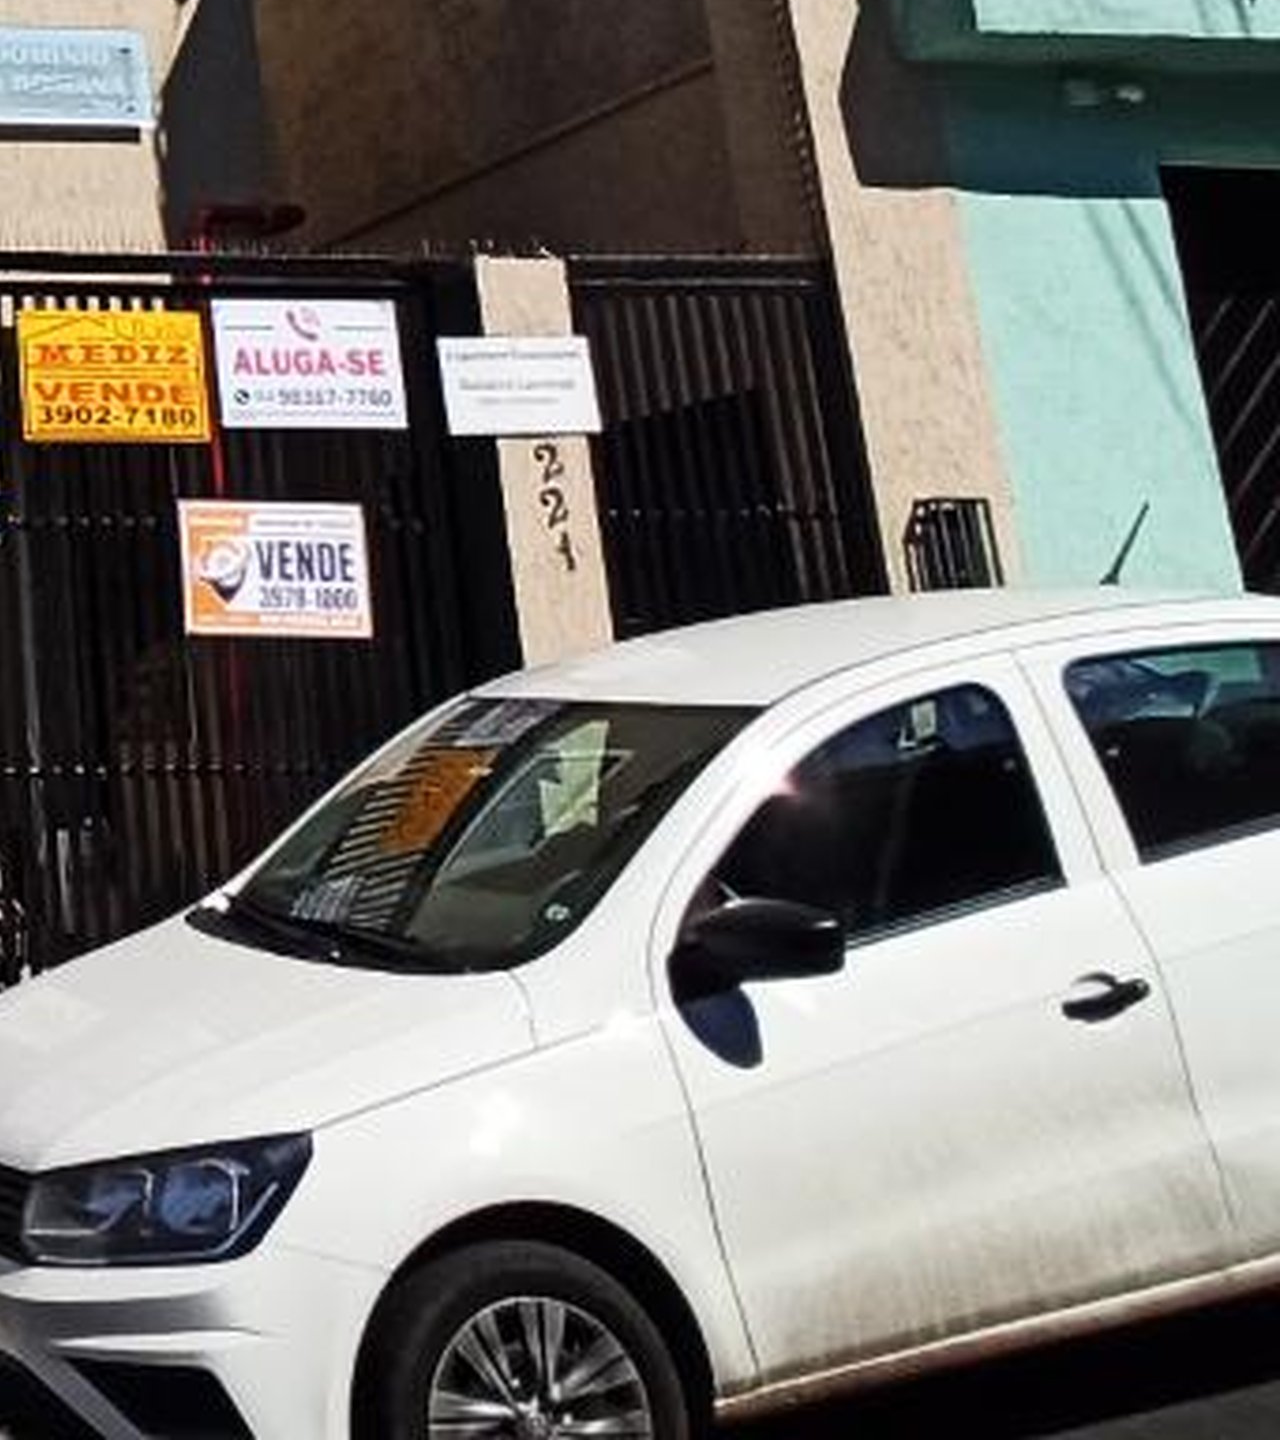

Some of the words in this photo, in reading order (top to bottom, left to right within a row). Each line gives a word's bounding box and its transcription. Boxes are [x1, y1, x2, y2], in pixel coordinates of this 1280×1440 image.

[233, 348, 388, 376] ALUGA-SE
[33, 382, 196, 405] VENDE
[255, 540, 356, 583] VENDE
